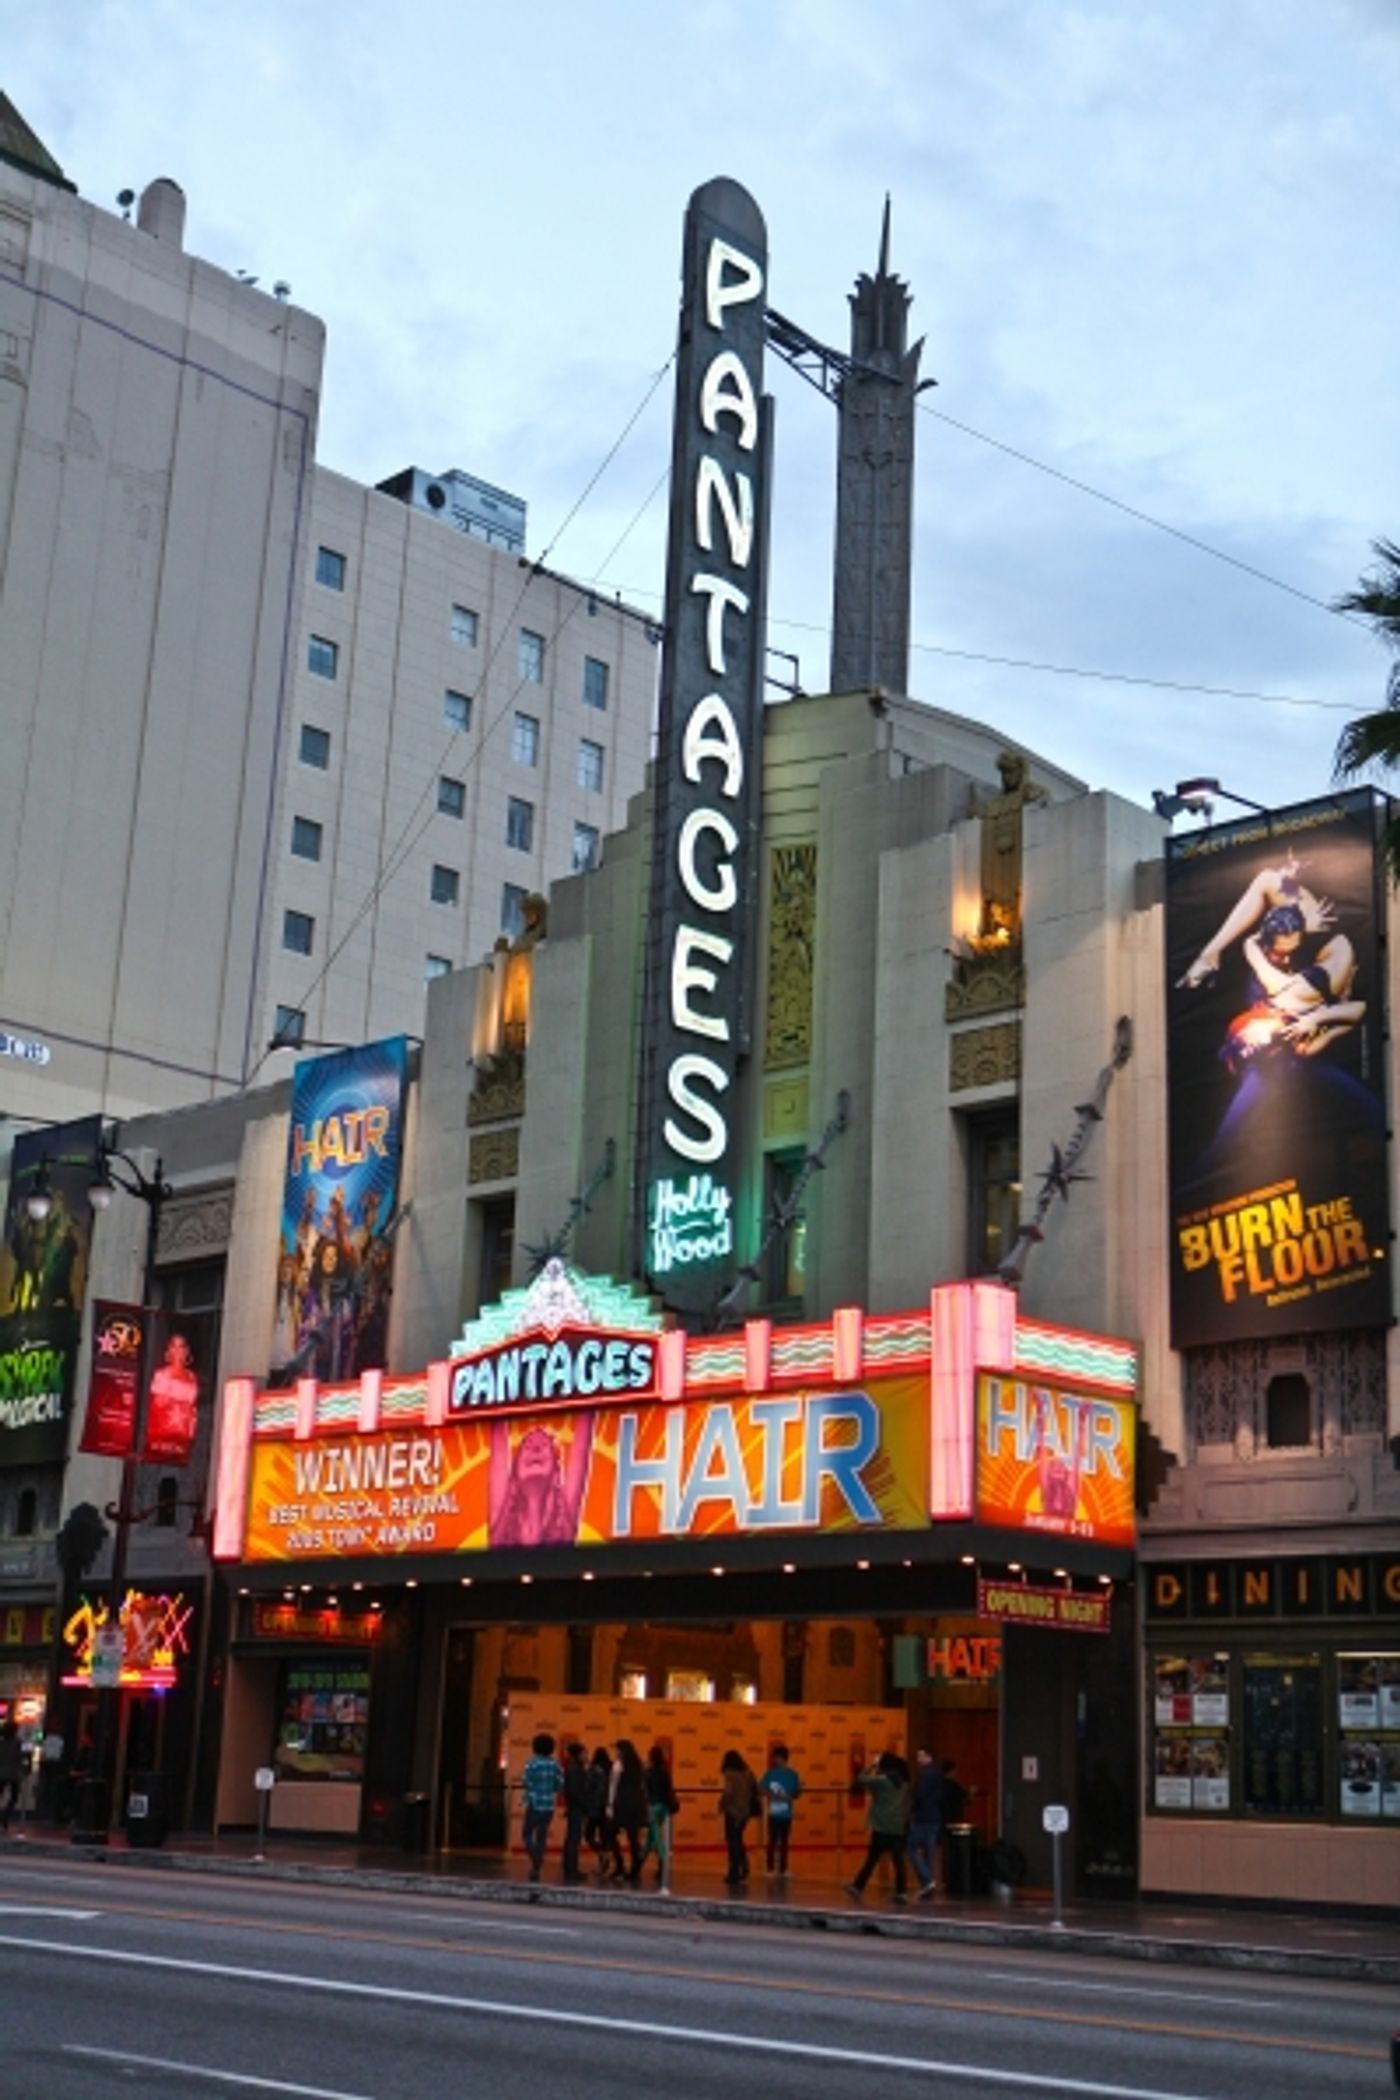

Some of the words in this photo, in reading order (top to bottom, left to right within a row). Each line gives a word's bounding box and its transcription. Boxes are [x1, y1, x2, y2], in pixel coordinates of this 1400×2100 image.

[663, 237, 764, 1163] PANTAGES
[291, 1105, 390, 1177] HAIR
[653, 1174, 732, 1229] Holly
[1179, 1192, 1304, 1272] BURN
[1305, 1196, 1352, 1230] THE
[452, 1340, 653, 1408] PANTAGES
[612, 1389, 884, 1538] HAIR
[986, 1377, 1123, 1480] HAIR
[294, 1438, 442, 1495] WINNER!
[268, 1504, 307, 1525] BEST
[313, 1500, 384, 1520] MUSICAL
[390, 1494, 459, 1516] REVIVAL
[987, 1590, 1055, 1618] OPENING
[1060, 1599, 1104, 1623] NIGHT
